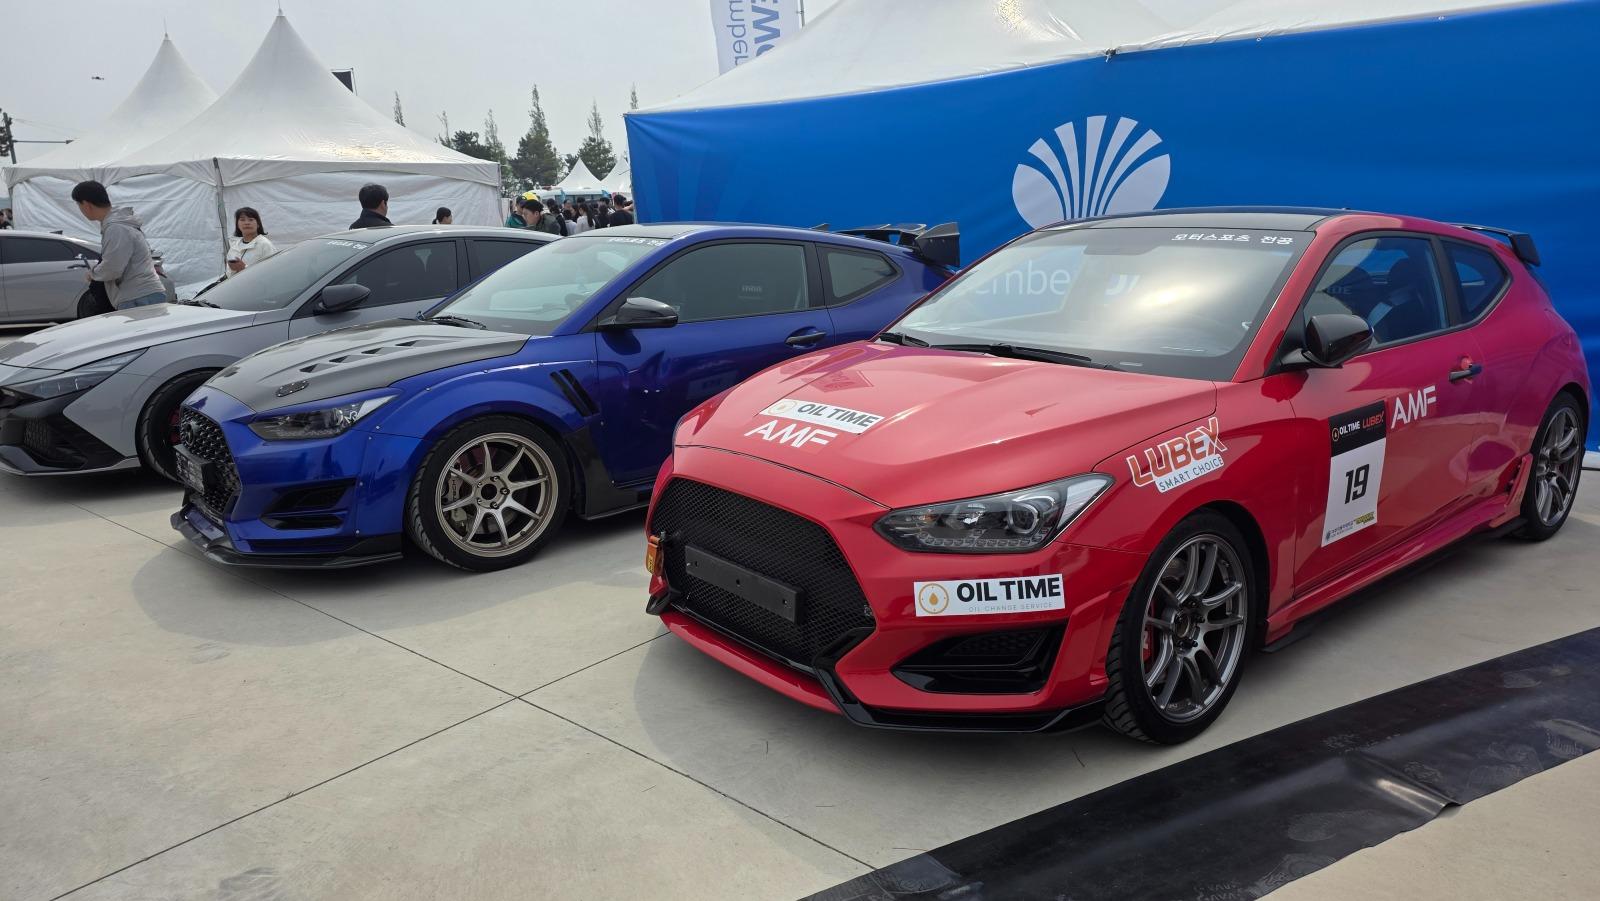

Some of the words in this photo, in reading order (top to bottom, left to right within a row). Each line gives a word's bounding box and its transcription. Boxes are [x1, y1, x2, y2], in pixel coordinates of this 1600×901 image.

[1171, 233, 1251, 242] 모터스포츠
[797, 403, 828, 417] OIL
[827, 408, 879, 428] TIME
[1362, 411, 1384, 429] LUBEX
[1391, 385, 1437, 429] AMF
[744, 419, 838, 448] AMF
[1126, 416, 1228, 487] LUBEX
[1158, 470, 1191, 491] SMART
[1192, 457, 1224, 476] CHOICE
[1344, 463, 1370, 504] 19
[956, 582, 998, 602] OIL
[999, 577, 1061, 600] TIME
[968, 605, 981, 613] OIL
[985, 604, 1018, 612] CHANGE
[1020, 602, 1053, 610] SERVICE
